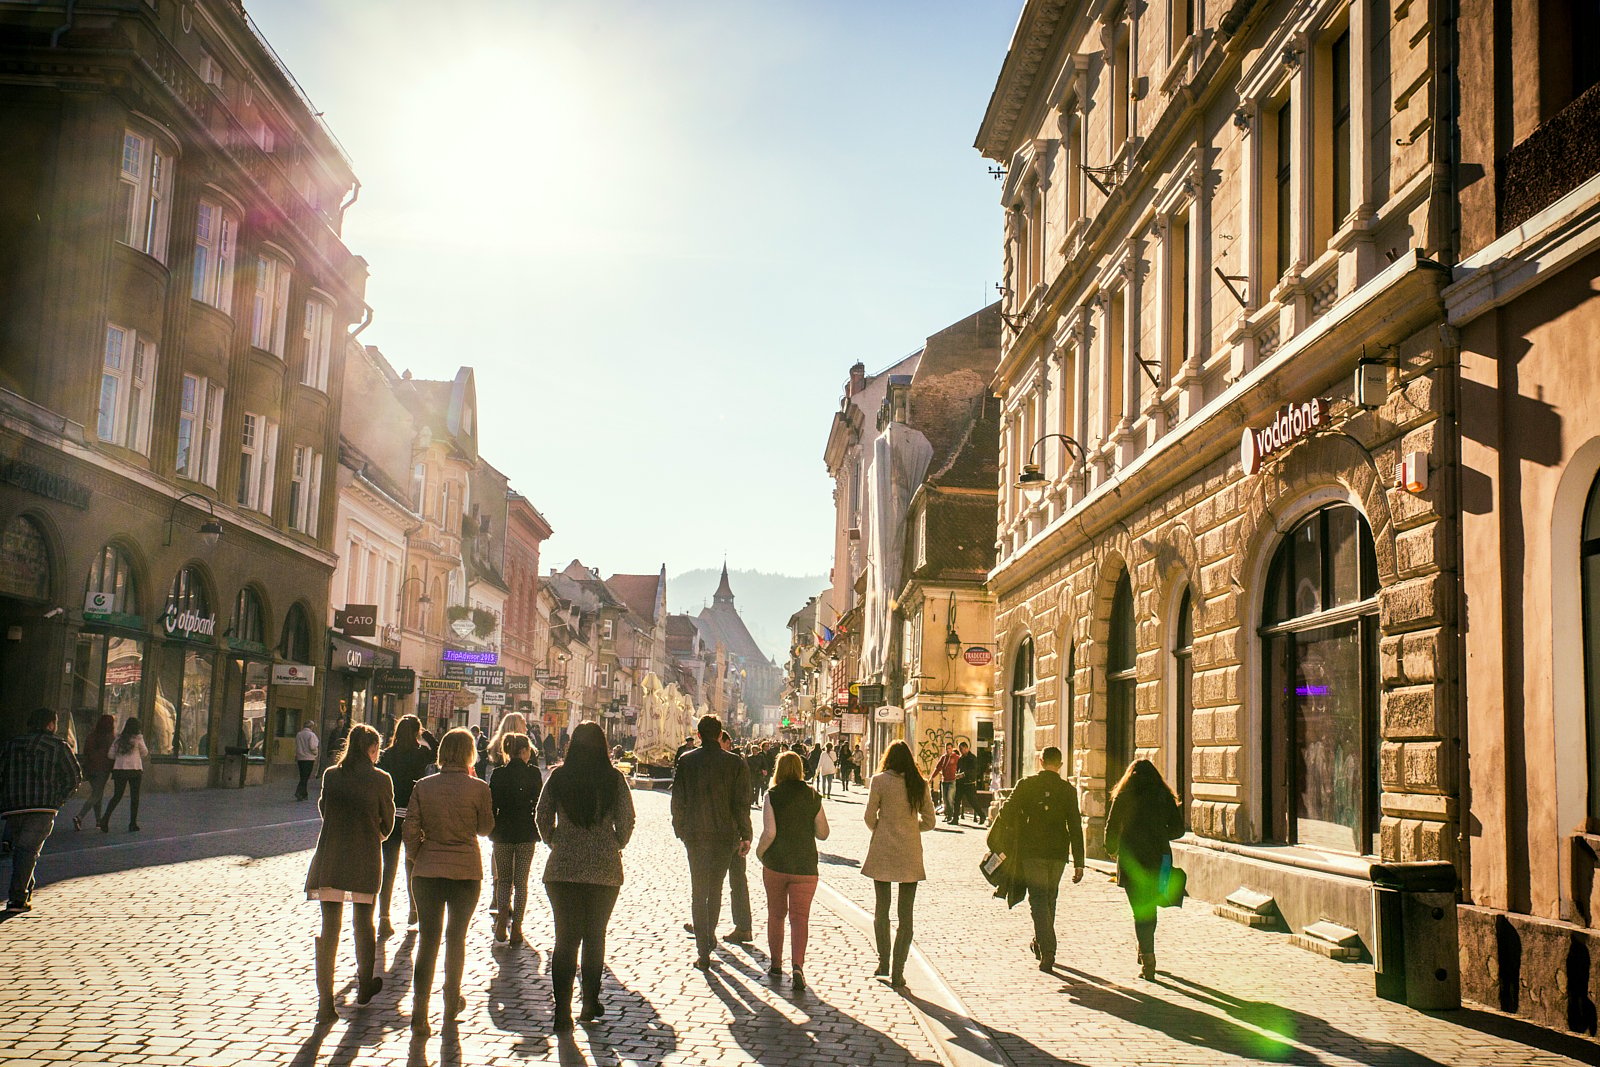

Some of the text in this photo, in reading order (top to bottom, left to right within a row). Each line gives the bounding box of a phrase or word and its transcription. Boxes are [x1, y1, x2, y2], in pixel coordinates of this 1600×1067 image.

[1256, 398, 1320, 457] vodafone
[178, 609, 216, 638] otpbank
[346, 615, 374, 625] CATO
[346, 649, 362, 668] CATO
[446, 650, 480, 660] TripAdvisor
[474, 669, 504, 677] elateria
[425, 680, 460, 690] EXCHANGE
[474, 676, 491, 685] ETTY
[491, 677, 504, 685] ICE
[508, 681, 528, 690] pebs
